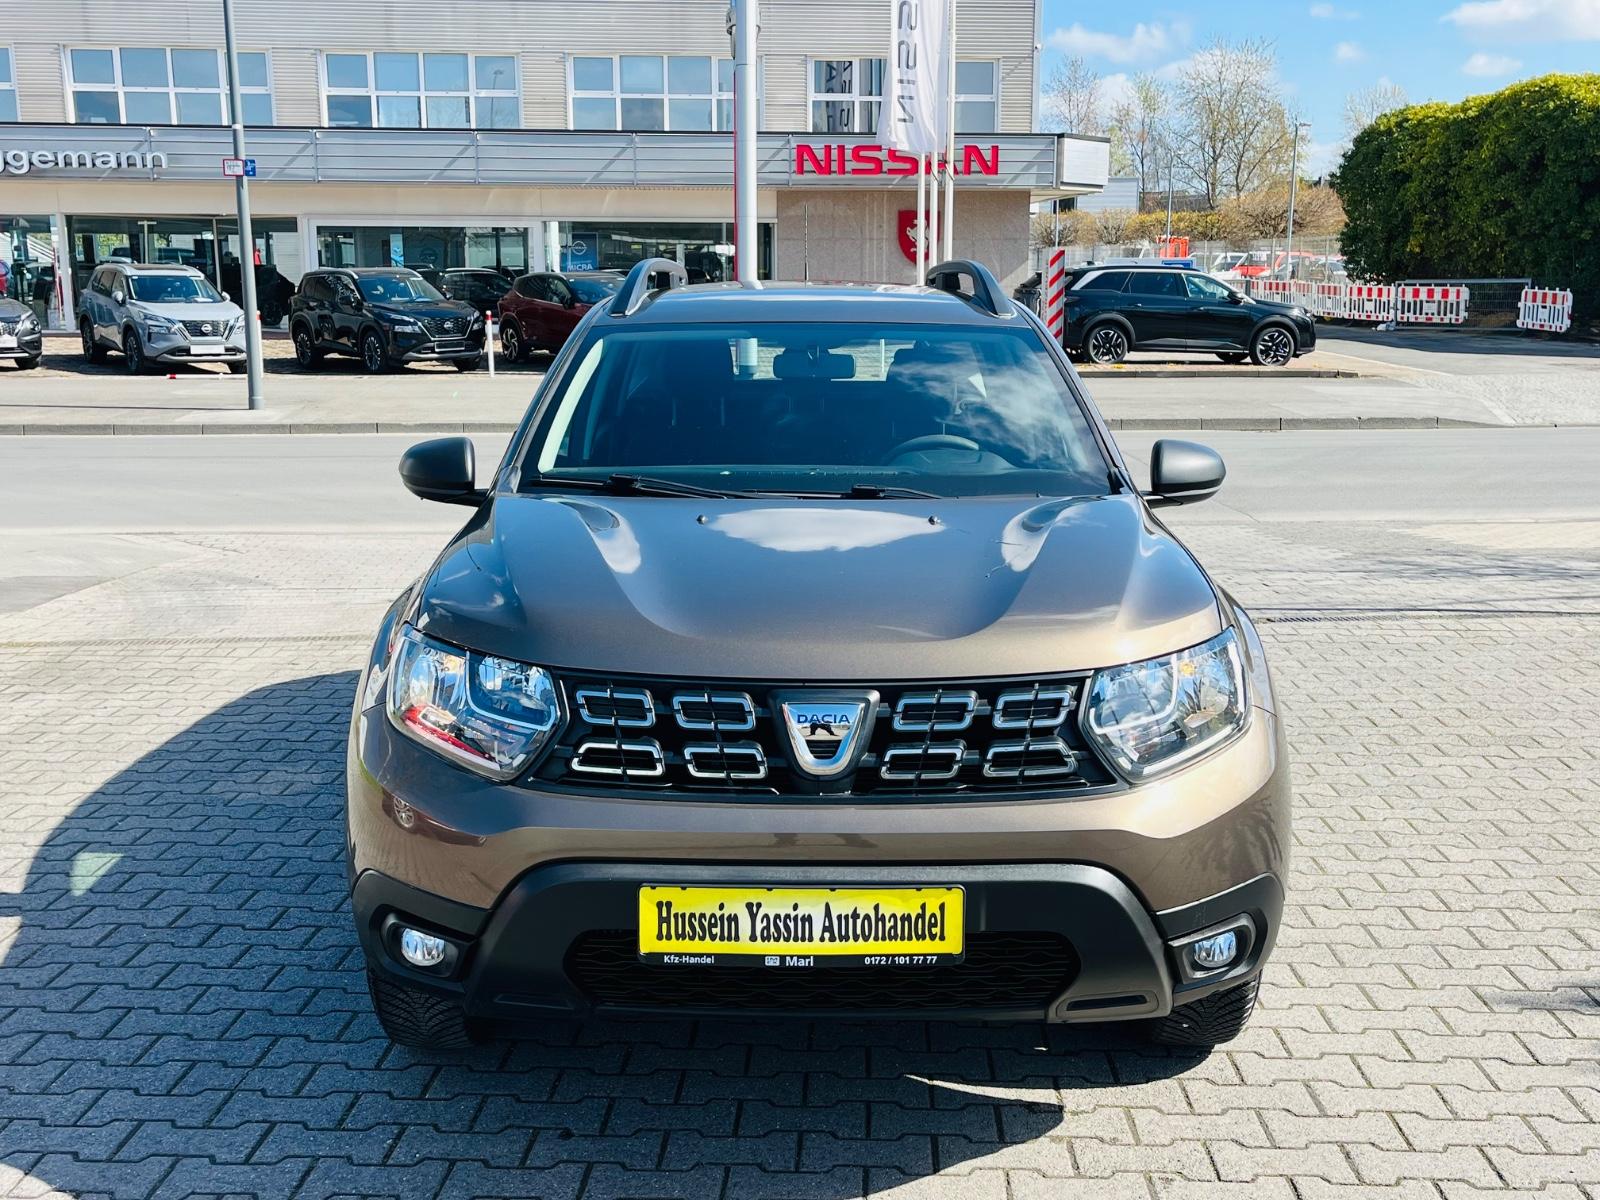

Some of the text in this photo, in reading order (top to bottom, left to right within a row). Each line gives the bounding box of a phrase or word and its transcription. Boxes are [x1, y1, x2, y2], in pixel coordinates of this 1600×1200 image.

[0, 149, 168, 174] gemann
[797, 714, 850, 724] DACIA
[656, 900, 946, 943] Hussein Yassin Autohandel
[664, 955, 715, 964] Kfz-Handel
[785, 956, 814, 967] Marl
[864, 956, 886, 965] 0172
[894, 956, 910, 965] 101
[912, 956, 924, 965] 77
[926, 956, 938, 965] 77
